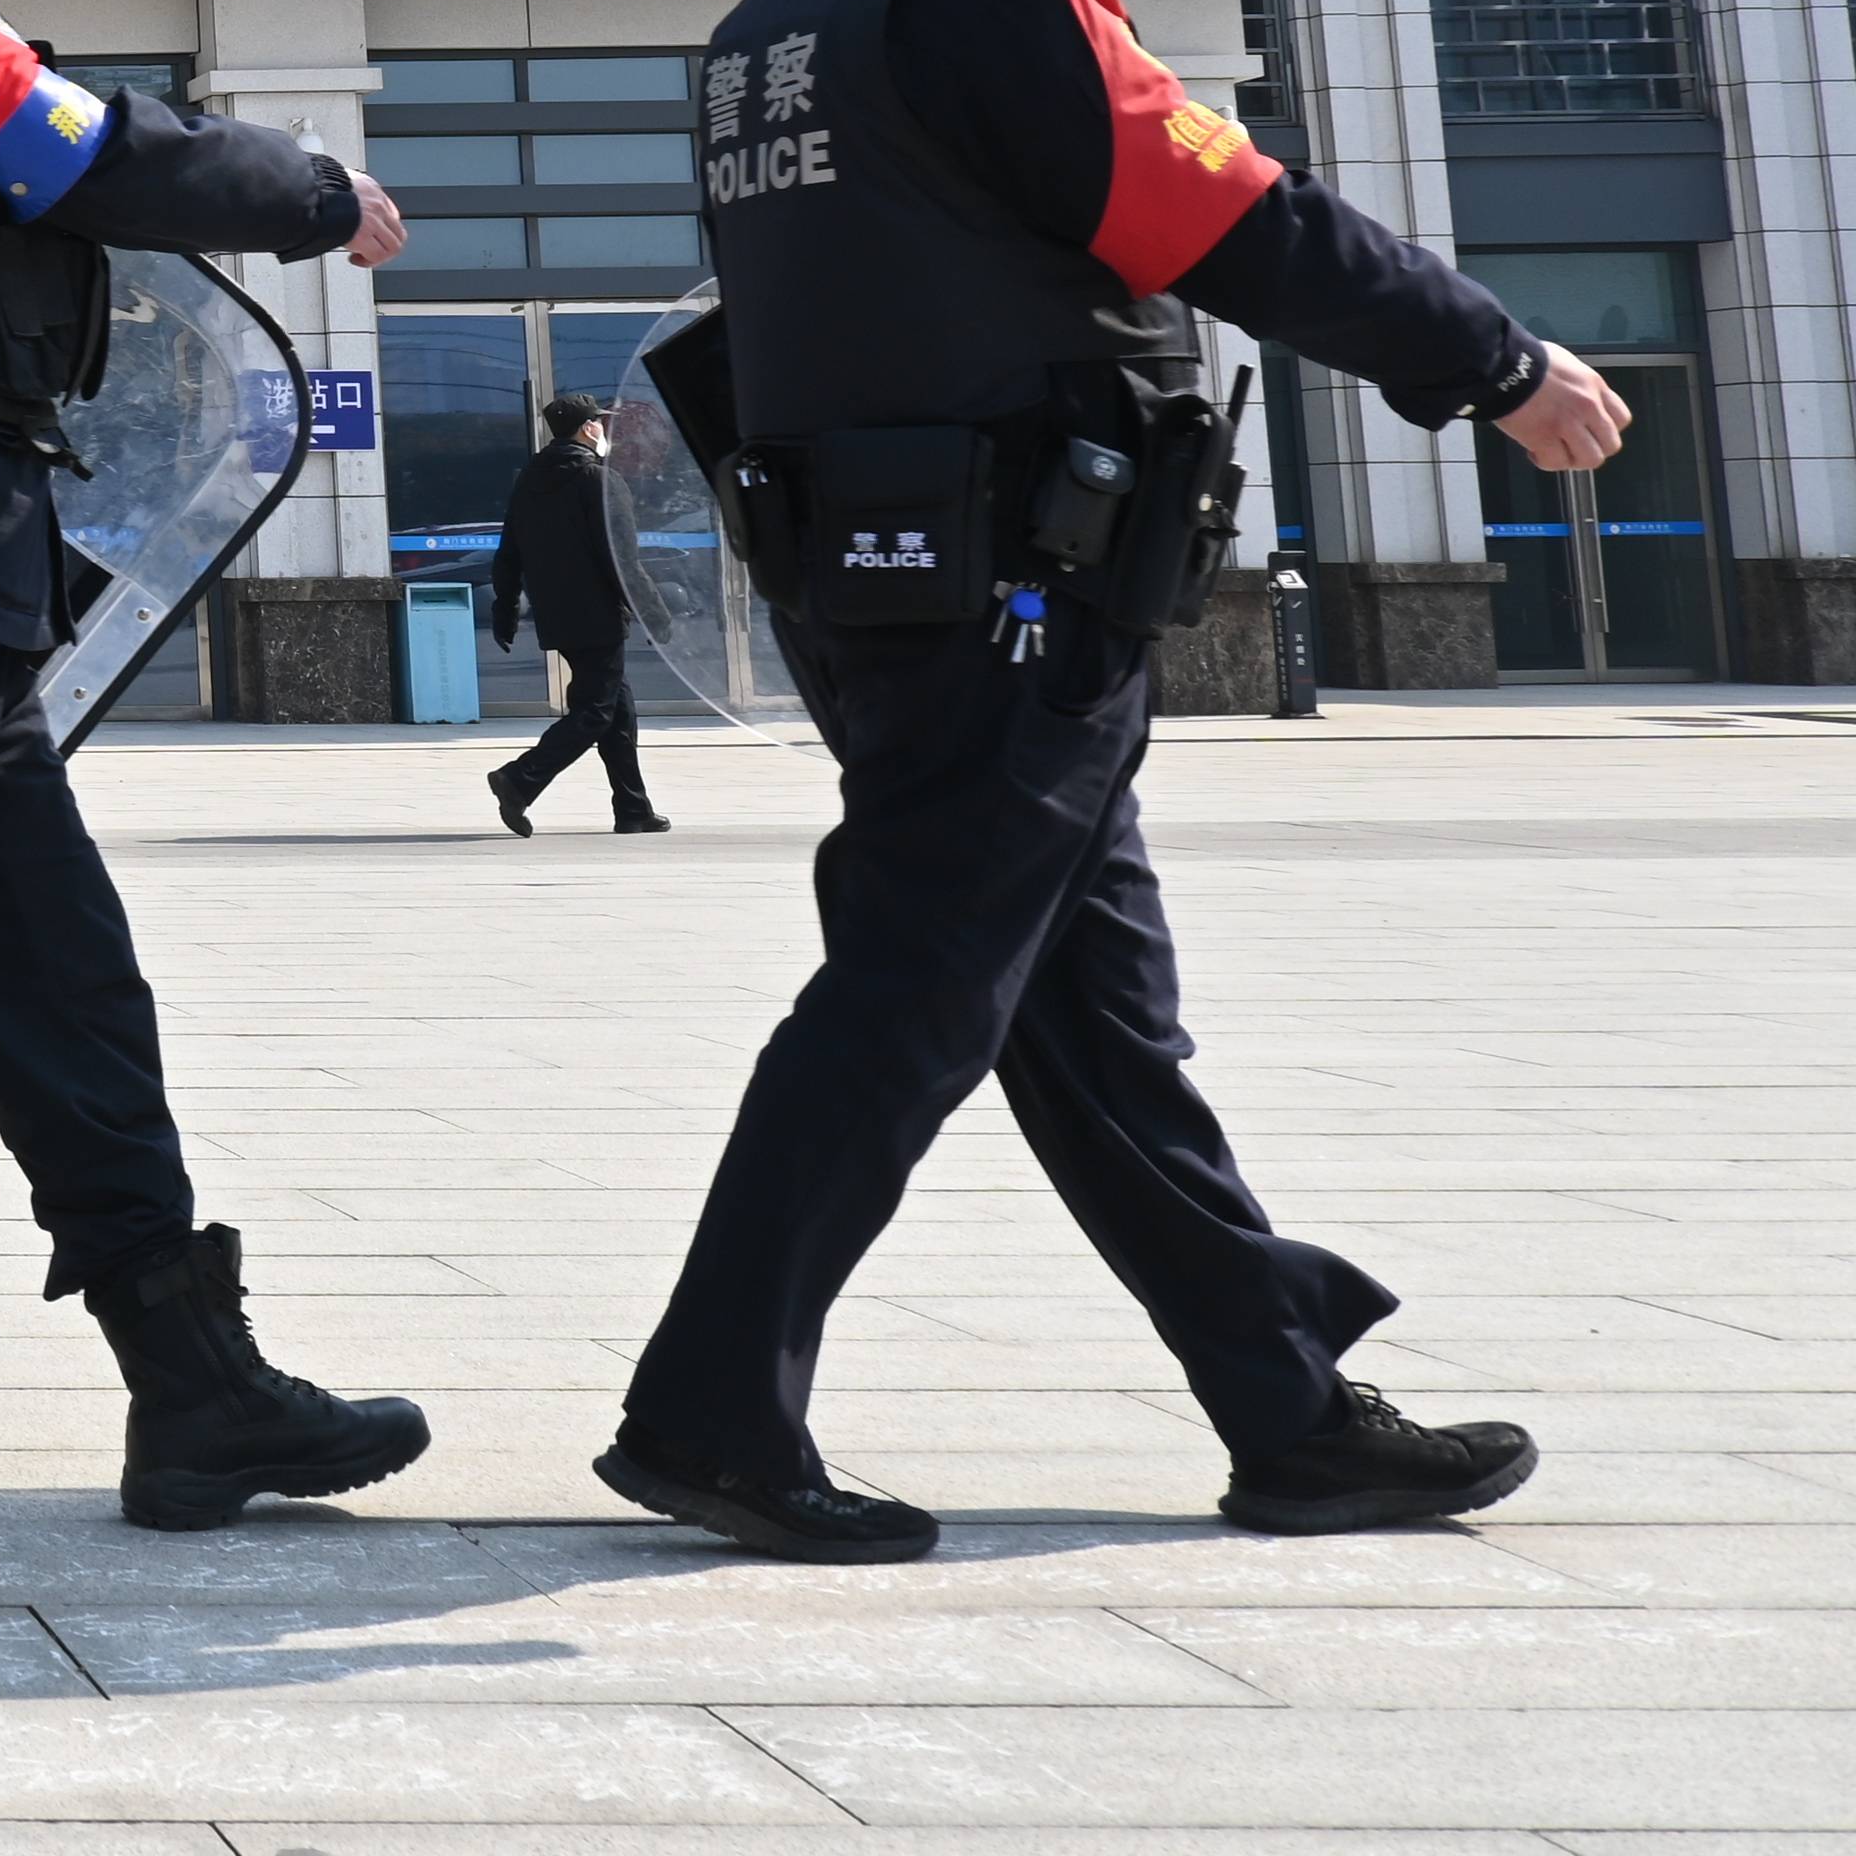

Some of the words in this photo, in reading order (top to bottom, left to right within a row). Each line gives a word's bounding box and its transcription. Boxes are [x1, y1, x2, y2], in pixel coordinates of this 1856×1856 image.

[706, 32, 817, 144] 警察
[707, 129, 837, 206] POLICE
[844, 552, 936, 568] POLICE
